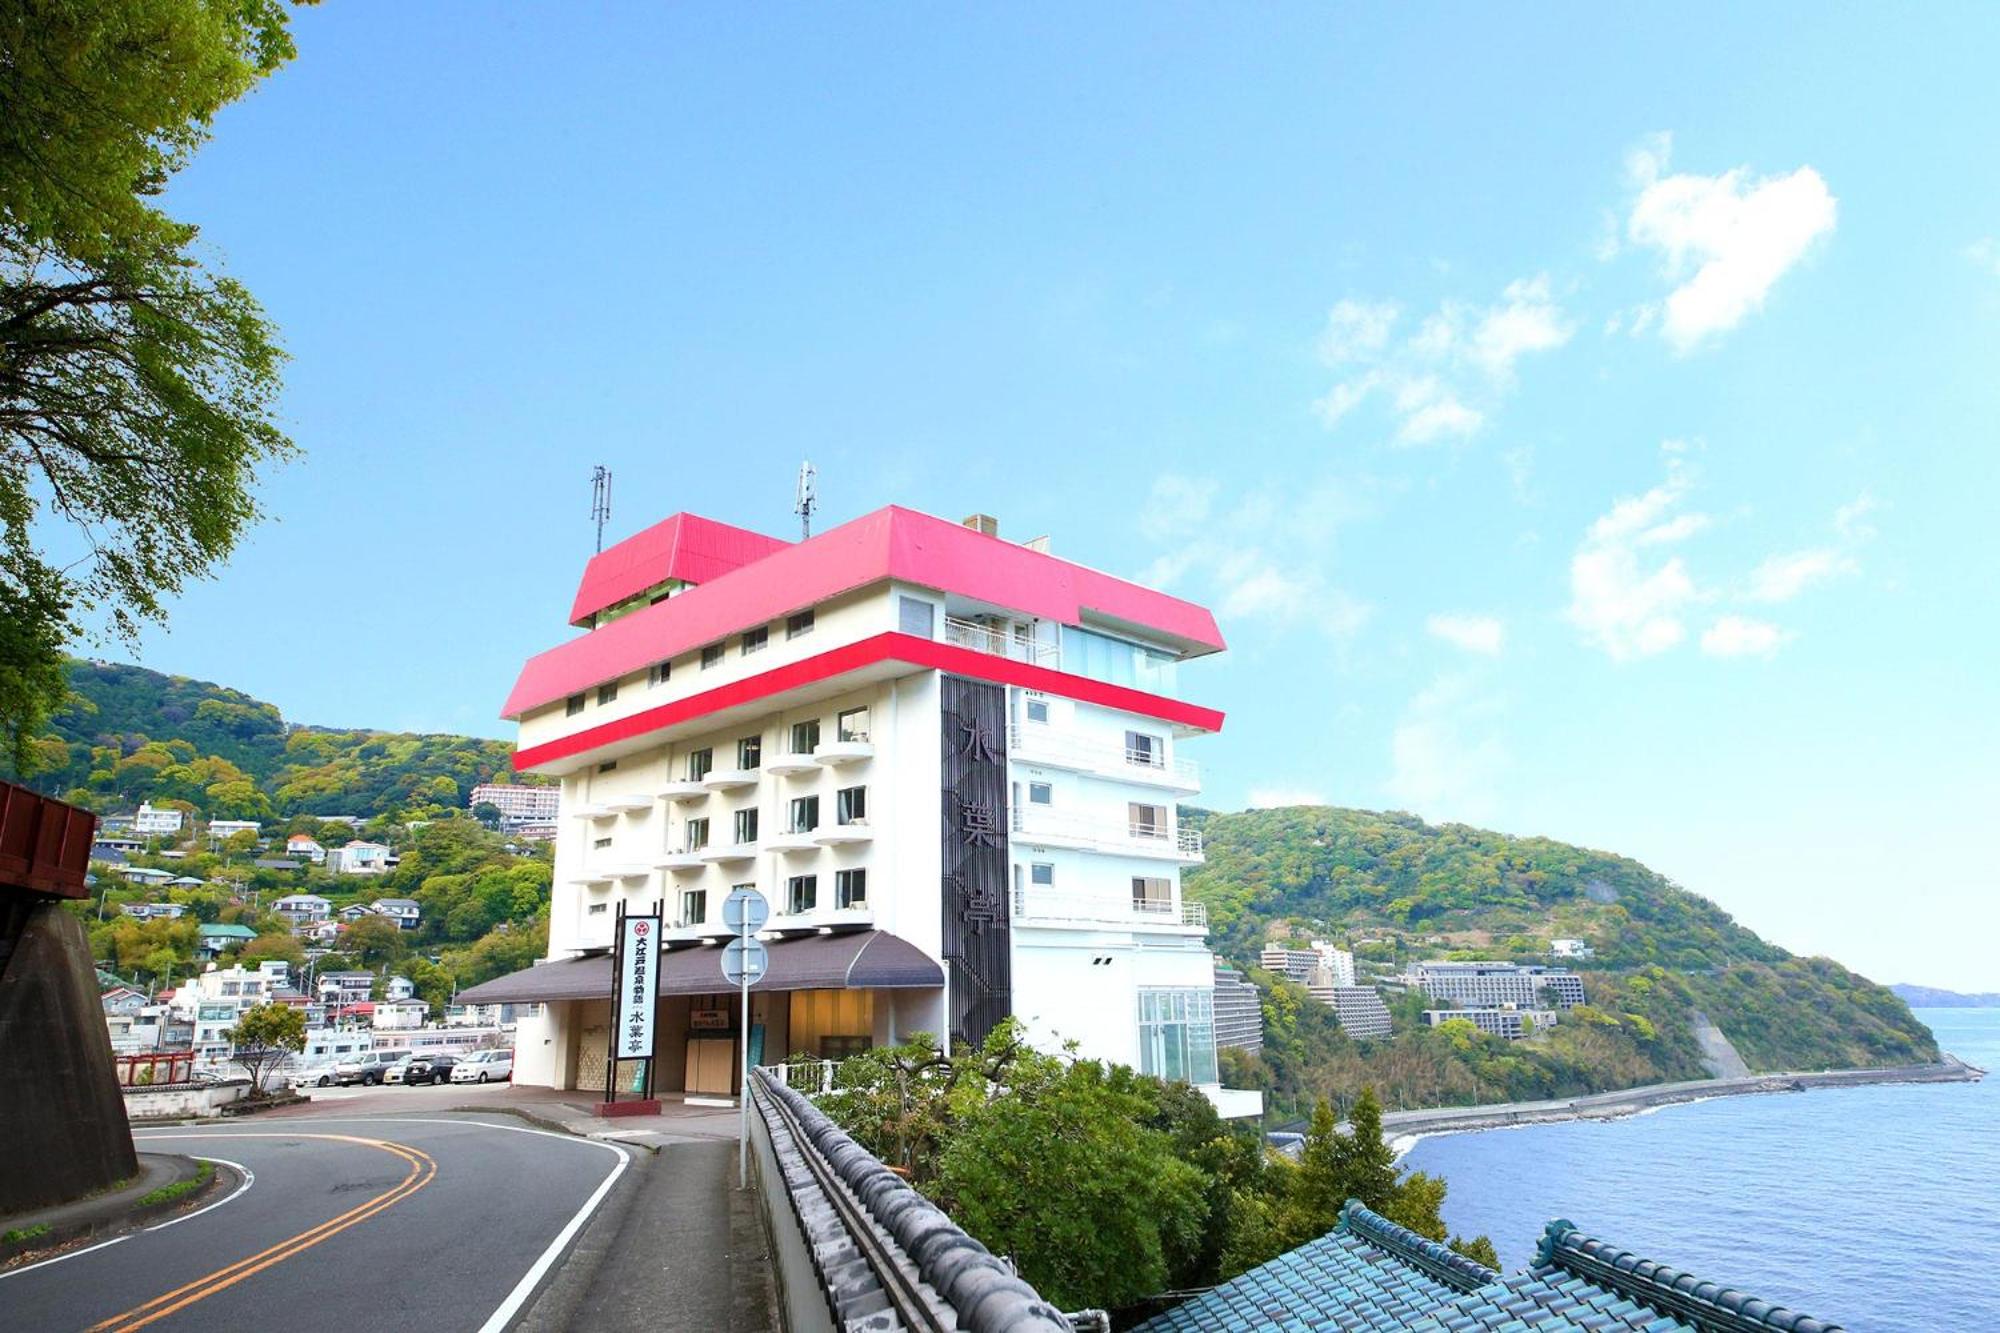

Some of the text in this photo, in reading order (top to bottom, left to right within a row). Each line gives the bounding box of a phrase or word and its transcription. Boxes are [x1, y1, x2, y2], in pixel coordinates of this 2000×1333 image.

[961, 717, 997, 935] 水葉亭
[628, 1011, 645, 1053] 水葉亭
